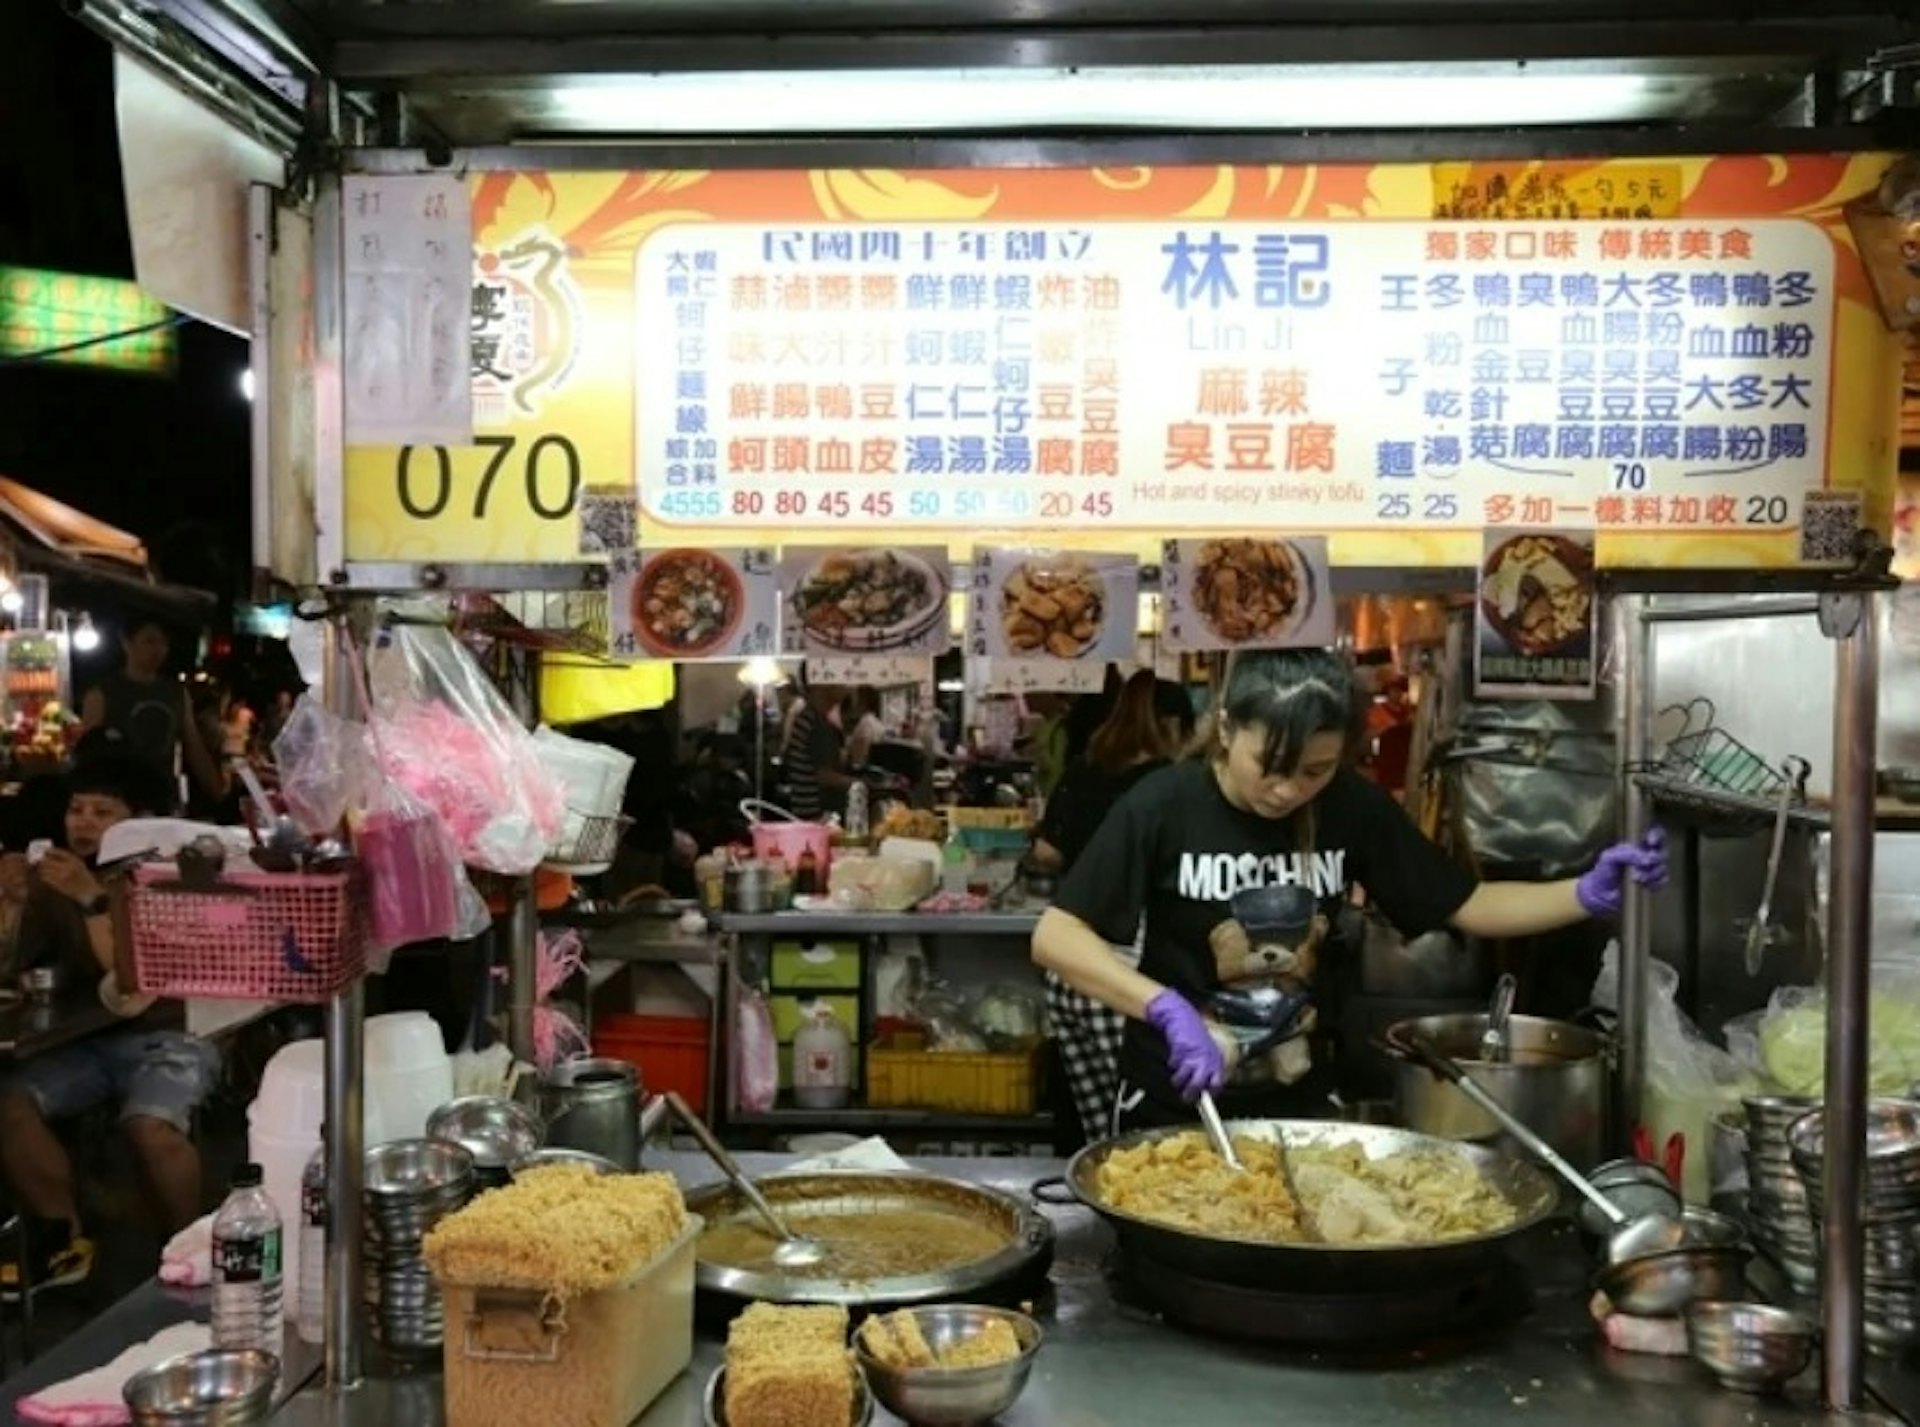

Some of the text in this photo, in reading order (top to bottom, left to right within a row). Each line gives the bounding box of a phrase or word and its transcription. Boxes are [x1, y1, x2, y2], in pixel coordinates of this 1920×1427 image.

[1425, 228, 1755, 260] 獨家口味 傳統美食
[1160, 230, 1332, 309] 林記
[1188, 315, 1294, 351] Lin Ji
[1376, 274, 1419, 478] 王子麵
[1469, 271, 1511, 459] 鴨血金針菇
[1512, 271, 1556, 459] 臭豆腐
[1555, 271, 1599, 459] 鴨血臭豆腐
[1600, 271, 1643, 459] 大腸臭豆腐
[1641, 271, 1685, 459] 冬粉臭豆腐
[1684, 271, 1727, 461] 鴨血大腸
[1726, 271, 1769, 461] 鴨血冬粉
[1770, 271, 1816, 459] 冬粉大腸
[1197, 366, 1309, 416] 麻辣
[1164, 420, 1337, 474] 臭豆腐
[397, 433, 581, 520] 070
[1132, 482, 1166, 501] Hot
[1171, 482, 1206, 501] and
[1213, 484, 1262, 504] spicy
[1328, 482, 1365, 502] tofu
[1613, 463, 1646, 490] 70
[731, 491, 763, 515] 80
[775, 491, 807, 515] 80
[817, 491, 850, 517] 45
[861, 491, 894, 517] 45
[909, 491, 940, 515] 50
[954, 491, 986, 515] 50
[1039, 491, 1074, 517] 20
[1081, 491, 1113, 516] 45
[1377, 494, 1411, 518] 25
[1423, 494, 1458, 518] 25
[1746, 496, 1788, 524] 20
